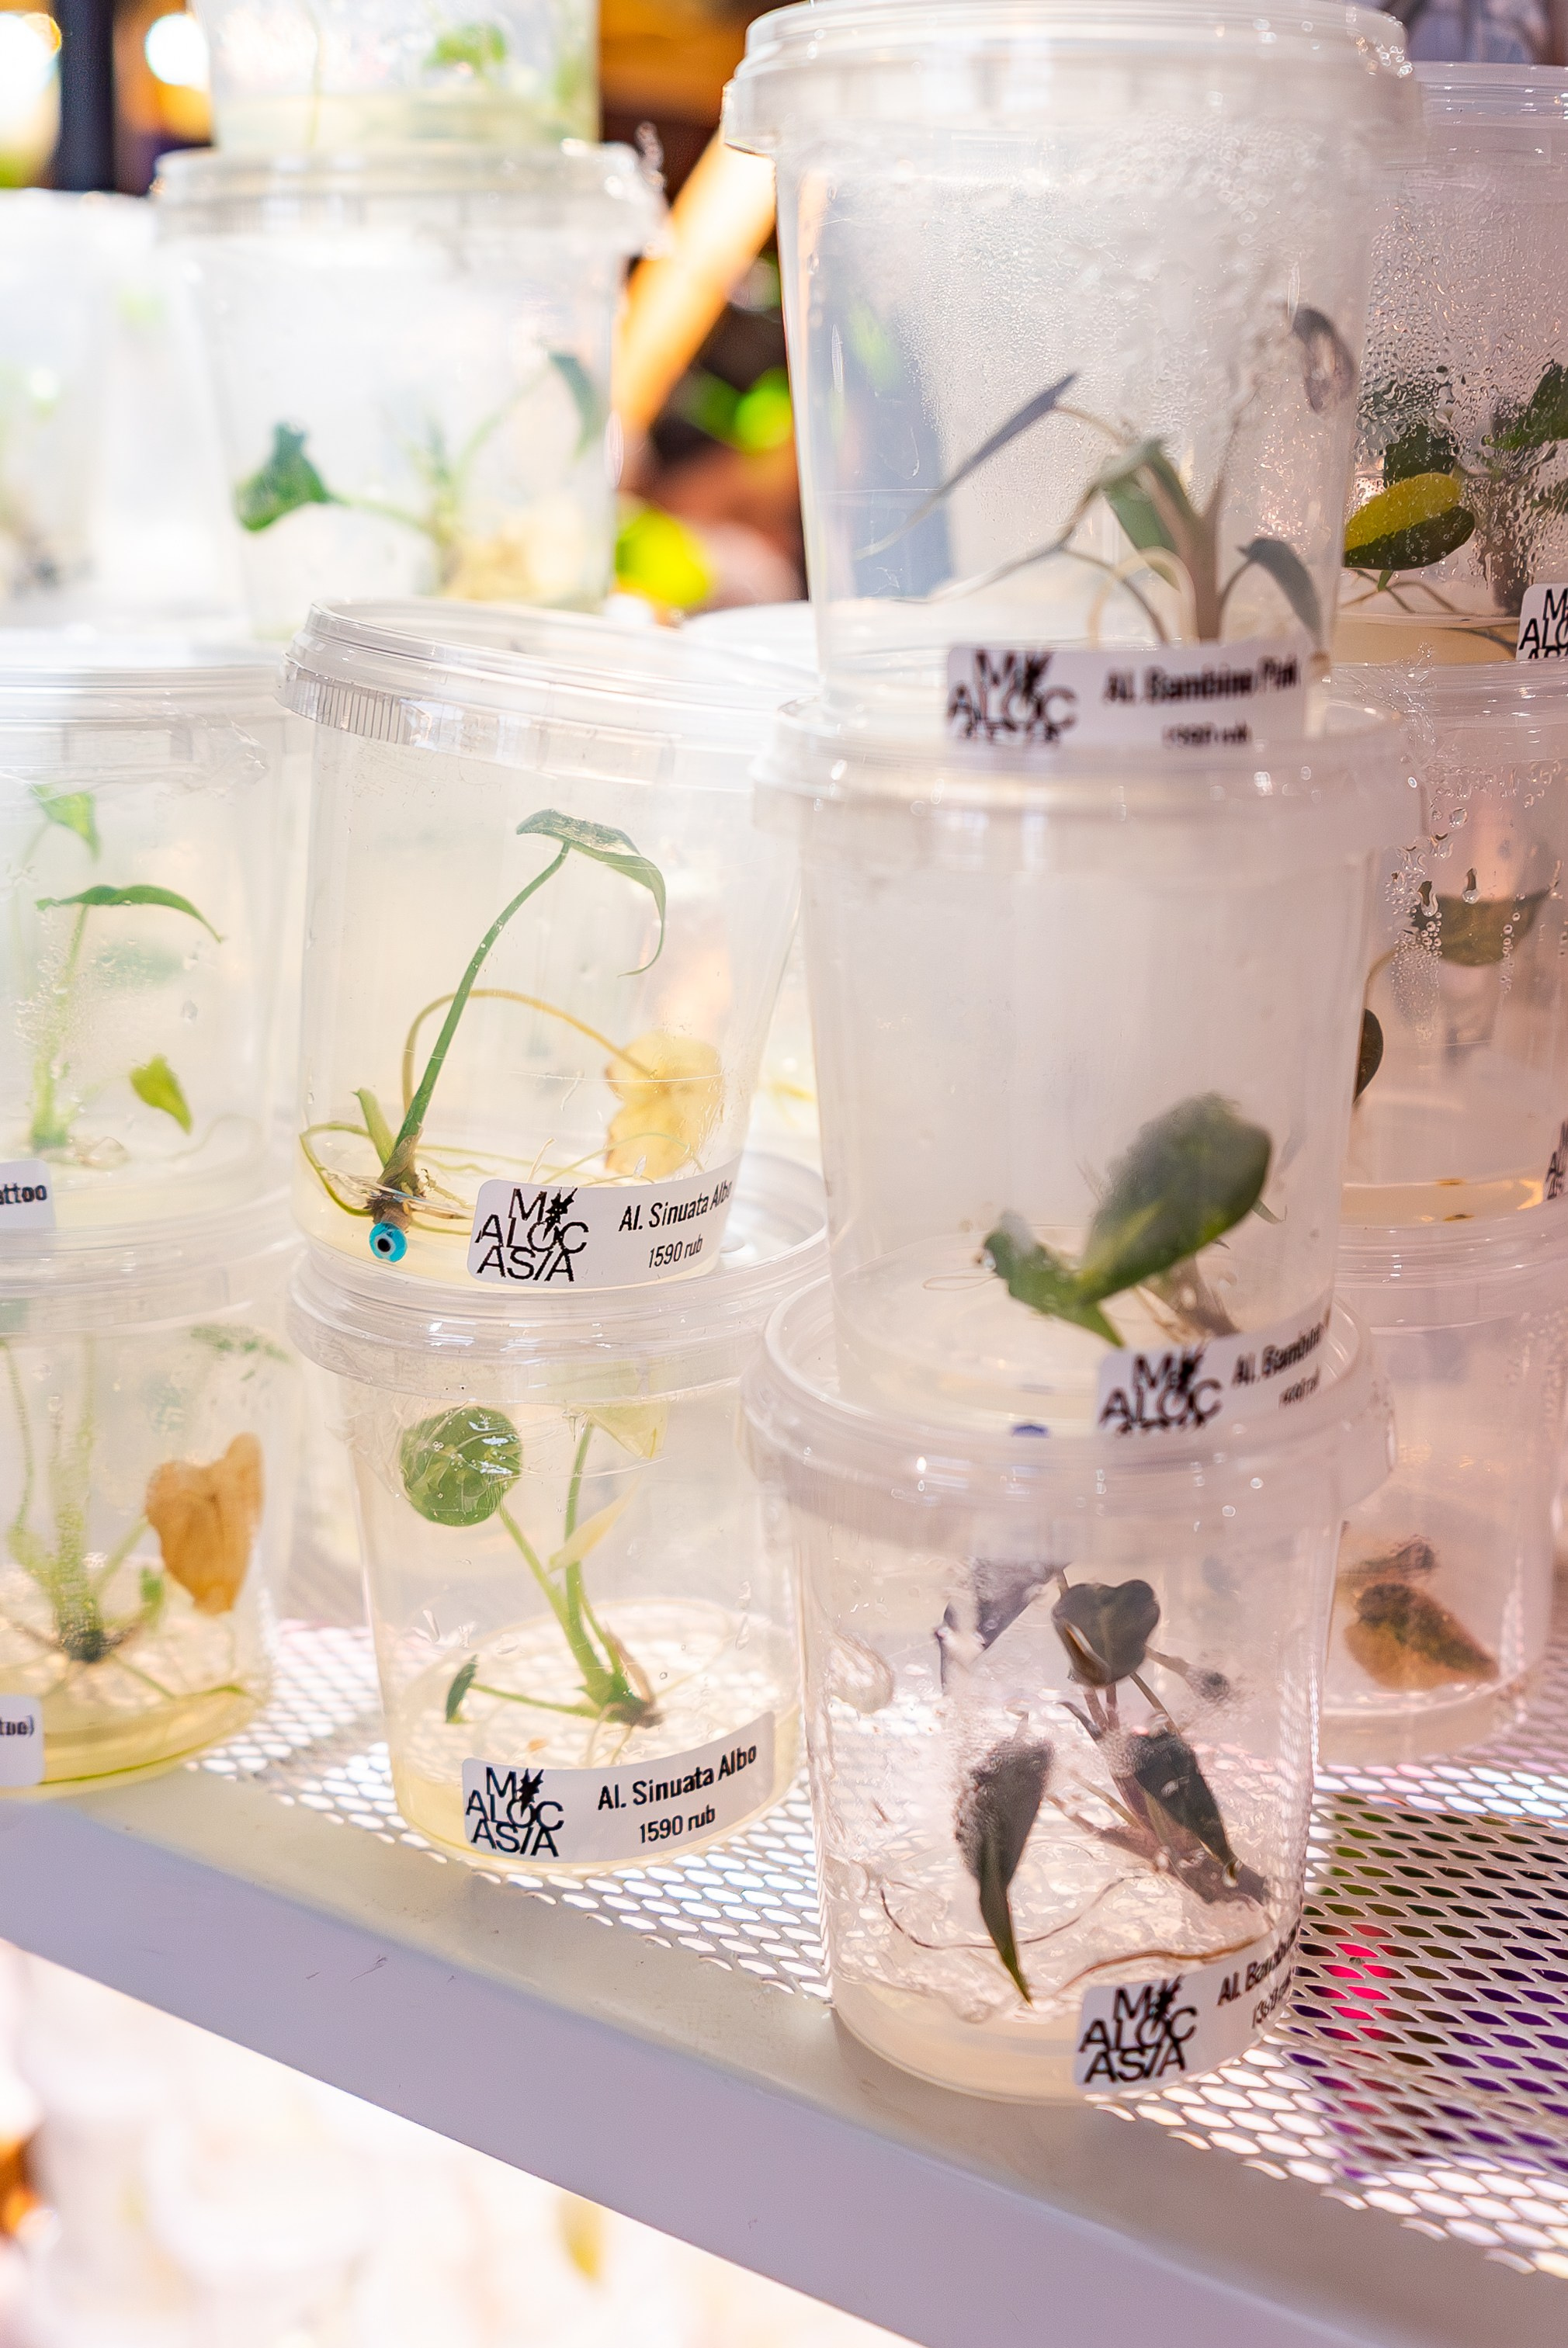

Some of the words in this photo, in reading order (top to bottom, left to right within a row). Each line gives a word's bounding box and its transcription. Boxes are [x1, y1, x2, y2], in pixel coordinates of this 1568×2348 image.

[618, 1204, 643, 1232] Al.
[648, 1192, 709, 1228] Sinuata
[649, 1240, 683, 1268] 1590
[684, 1233, 703, 1259] rub
[598, 1784, 626, 1811] Al.
[633, 1767, 715, 1806] Sinuata
[718, 1745, 758, 1781] Albo
[470, 1819, 560, 1857] ASIA
[640, 1815, 684, 1844] 1590
[688, 1804, 716, 1832] rub
